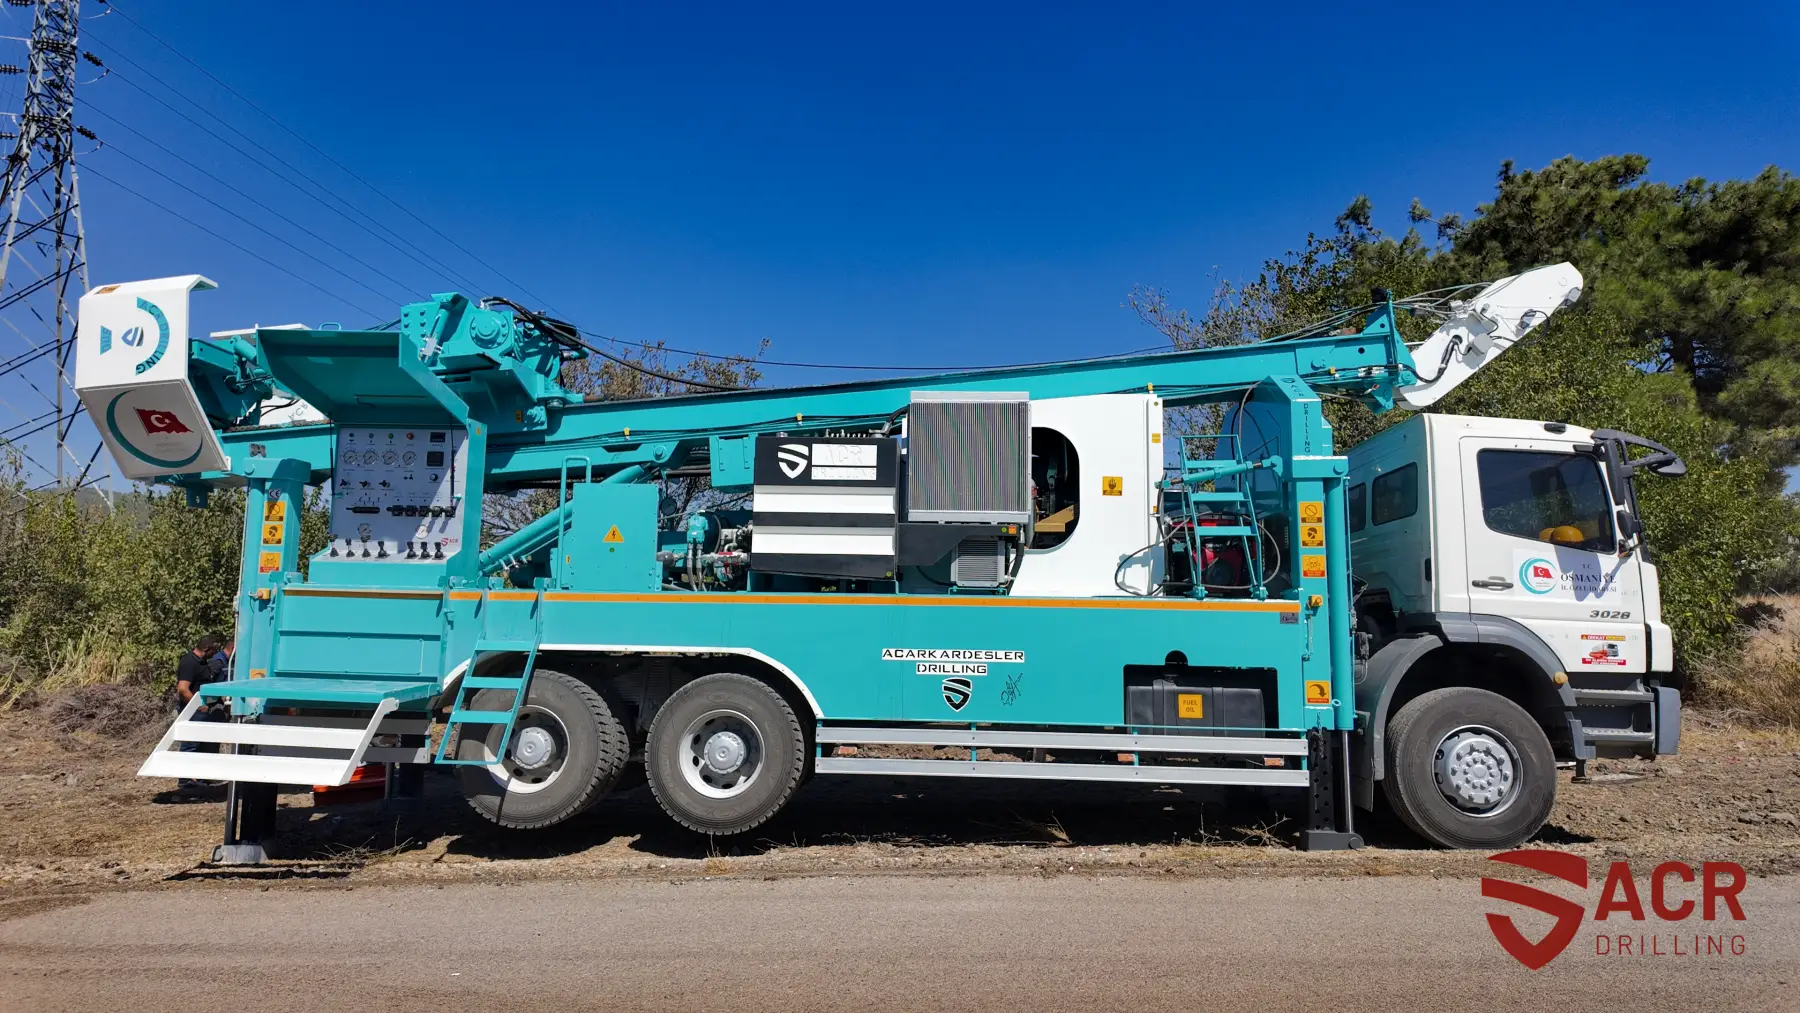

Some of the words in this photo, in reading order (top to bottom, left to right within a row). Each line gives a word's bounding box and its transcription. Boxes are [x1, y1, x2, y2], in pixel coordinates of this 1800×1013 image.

[1303, 403, 1311, 453] DRILLING
[1589, 609, 1631, 620] 3028
[882, 649, 1024, 661] ACARKARDESLER
[917, 663, 987, 674] DRILLING
